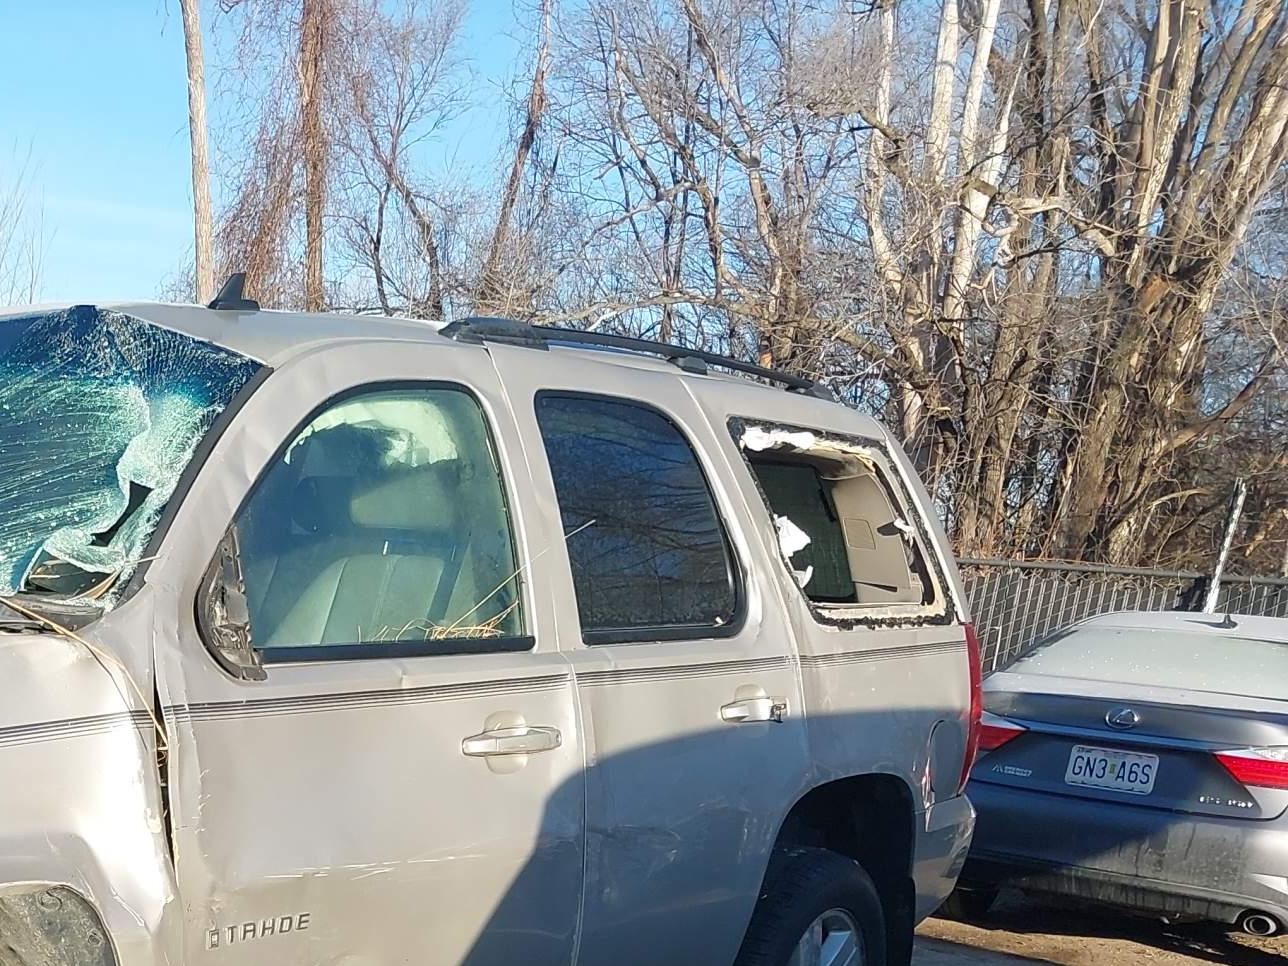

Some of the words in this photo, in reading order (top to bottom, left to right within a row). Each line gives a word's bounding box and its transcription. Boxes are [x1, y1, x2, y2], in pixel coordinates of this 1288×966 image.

[1071, 755, 1108, 779] GN3
[1115, 761, 1152, 785] A6S
[223, 912, 311, 945] TAHOE
